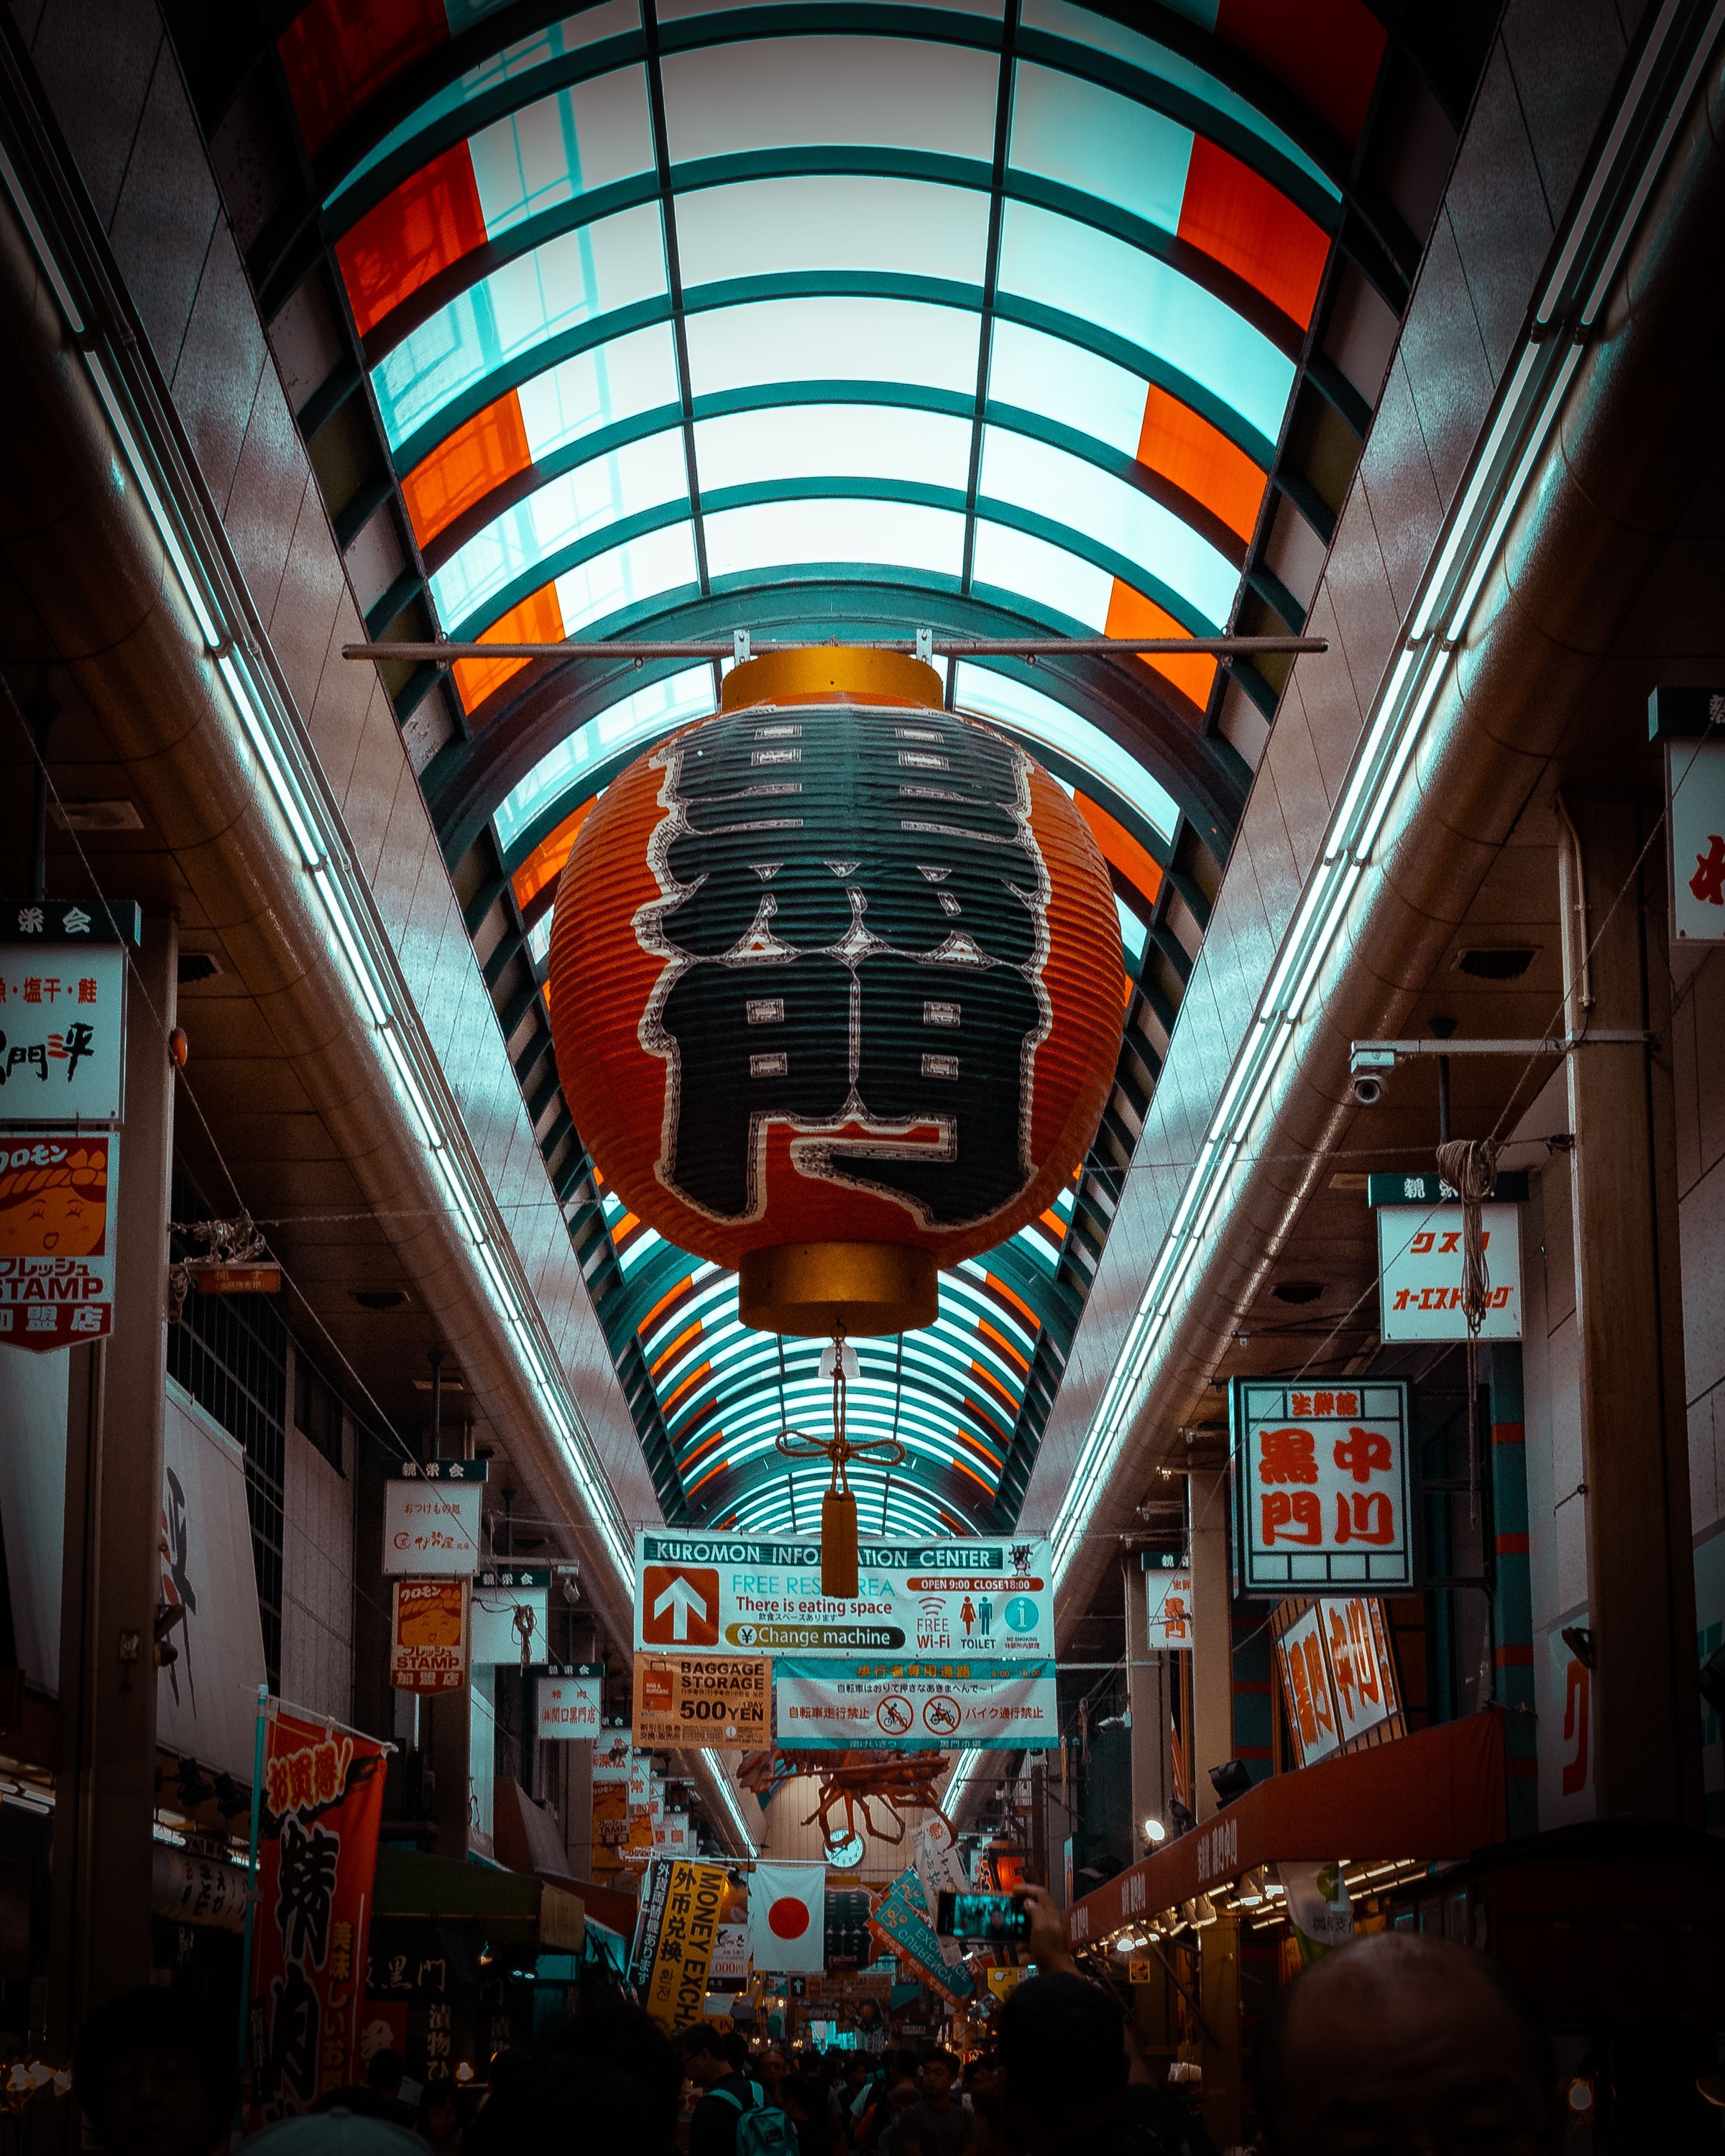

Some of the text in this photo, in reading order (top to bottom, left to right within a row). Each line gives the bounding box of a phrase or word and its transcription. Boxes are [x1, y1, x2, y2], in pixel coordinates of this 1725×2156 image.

[630, 703, 1054, 1235] 黒門
[1404, 1177, 1495, 1199] 親栄
[0, 1277, 104, 1301] TAMP
[1291, 1391, 1358, 1416] 生鮮館
[1259, 1427, 1395, 1546] 黒門 中川
[657, 1542, 990, 1567] KUROMON INFOTION CENTER
[732, 1575, 896, 1597] FREE RES REA
[921, 1579, 948, 1590] OPEN
[949, 1579, 970, 1590] 9:00
[736, 1595, 893, 1617] There is eating space
[916, 1618, 949, 1632] FREE
[758, 1626, 819, 1646] Change
[822, 1628, 891, 1646] machine
[916, 1634, 950, 1649] Wi-Fi
[960, 1639, 996, 1649] TOILET
[396, 1657, 460, 1669] STAMP
[681, 1662, 764, 1676] BAGGAGE
[681, 1675, 764, 1690] STORAGE
[788, 1707, 870, 1720] 自転車走行禁止
[965, 1706, 1044, 1720] バイク通行禁止
[939, 1739, 982, 1749] 黒門市場
[660, 1867, 697, 1965] 外币兑换
[688, 1871, 724, 1955] MONEY
[712, 1962, 744, 1974] ,000円
[672, 1958, 707, 2035] EXCHA
